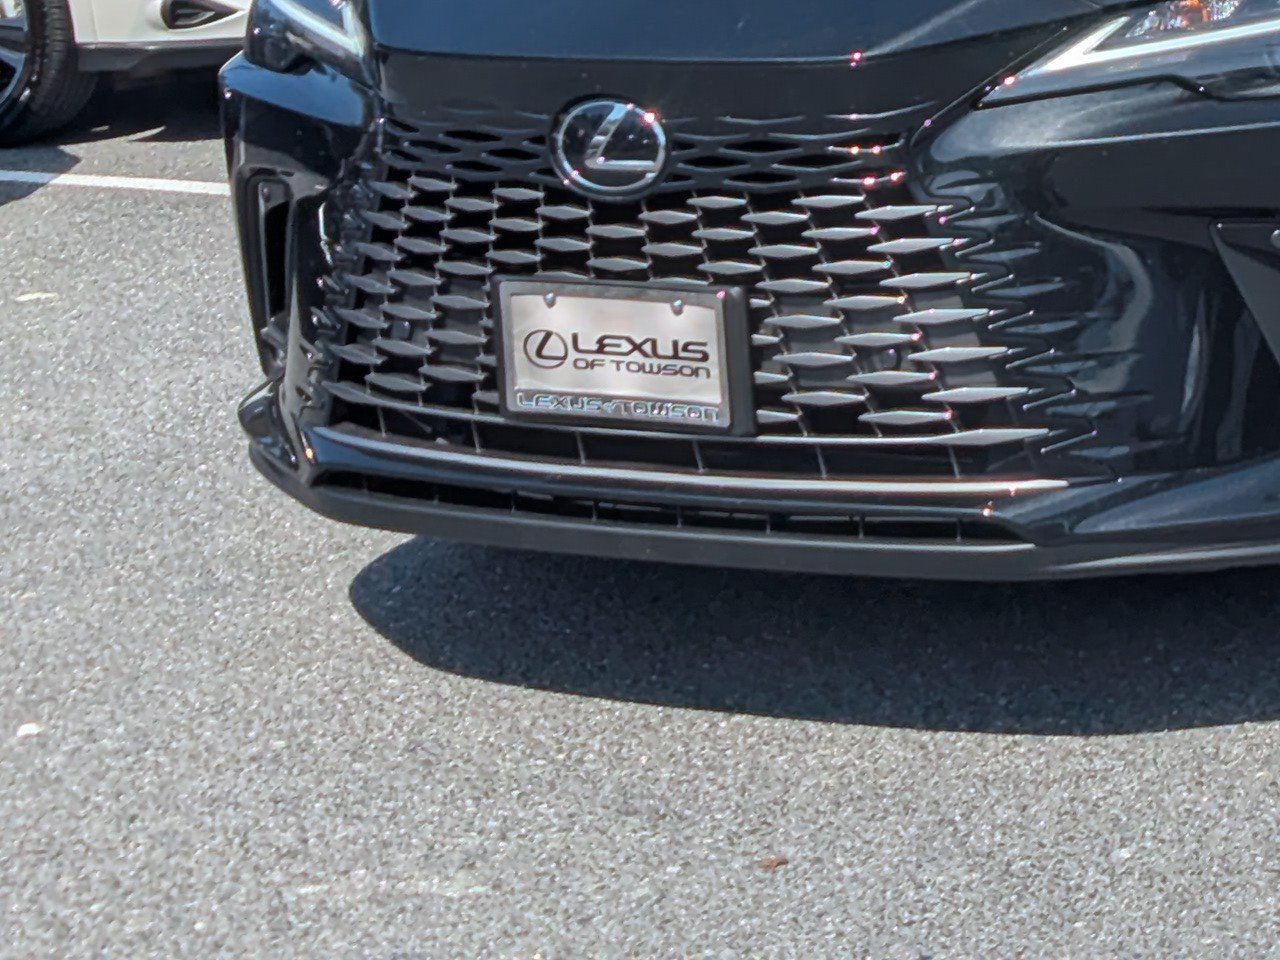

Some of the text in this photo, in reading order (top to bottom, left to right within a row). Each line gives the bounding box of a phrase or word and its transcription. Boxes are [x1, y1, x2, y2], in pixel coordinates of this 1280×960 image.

[571, 332, 710, 363] LEXUS
[573, 358, 711, 379] OF TOWSON
[516, 391, 600, 412] LEXUS
